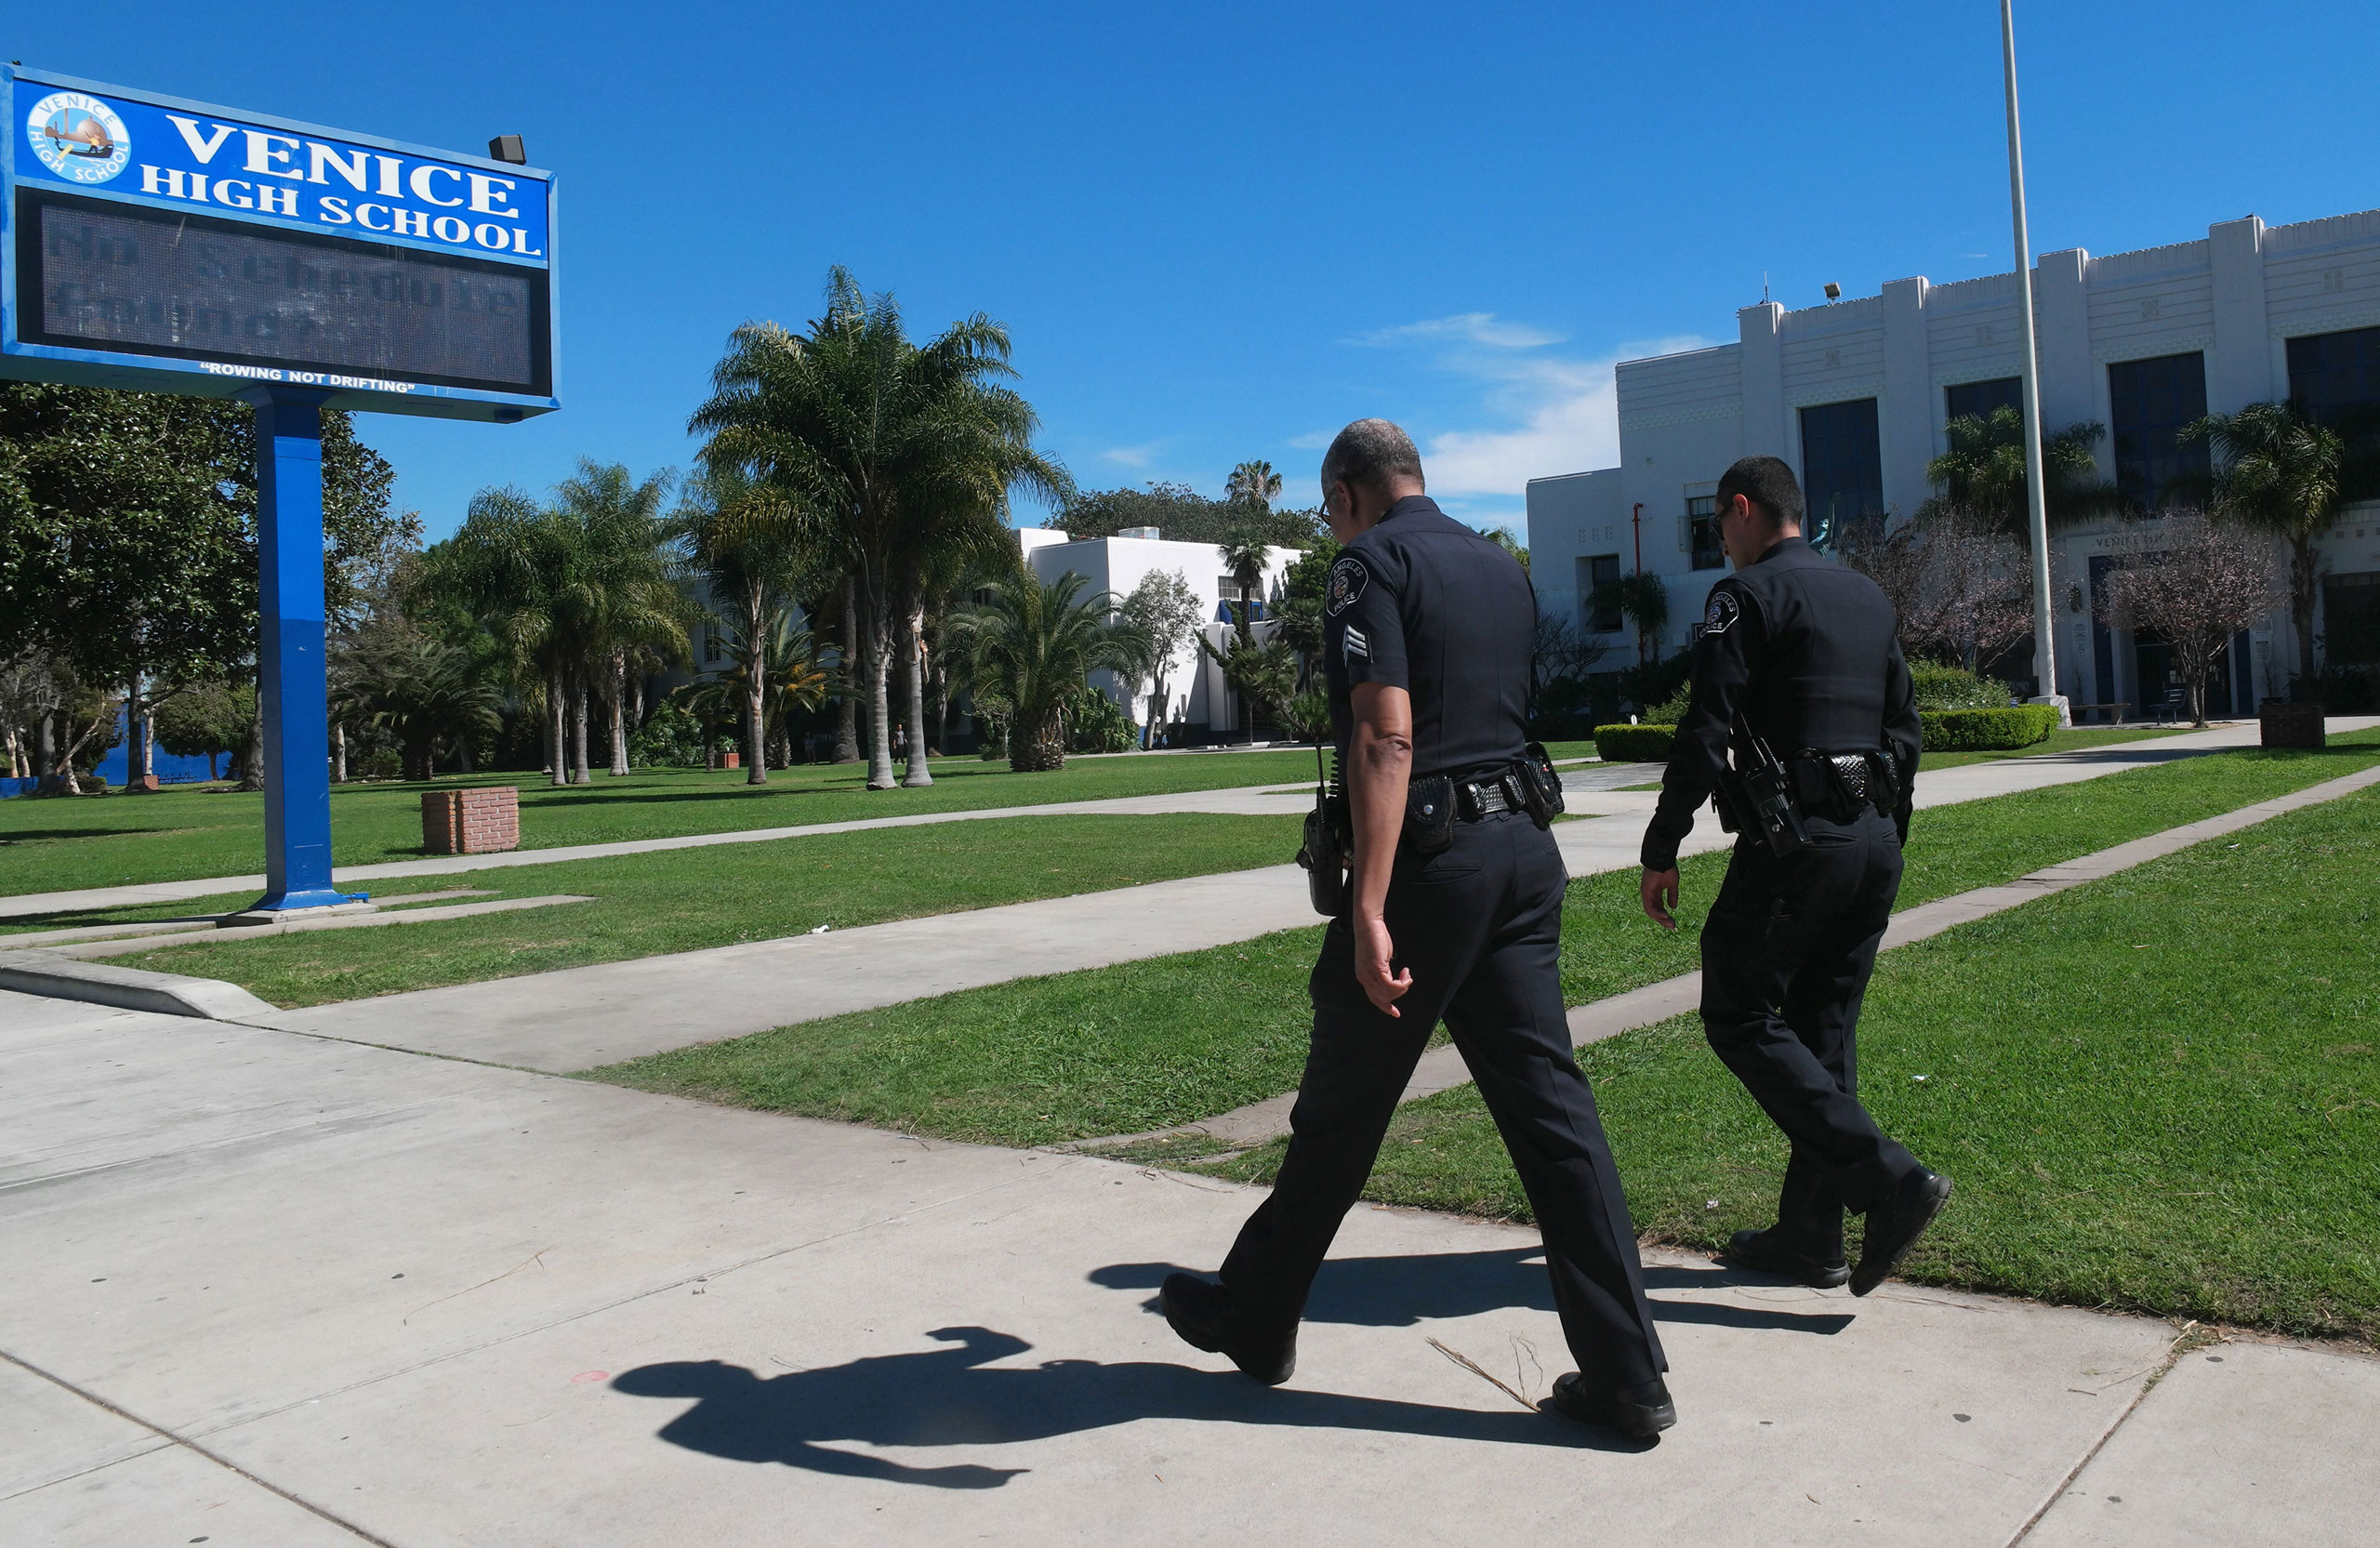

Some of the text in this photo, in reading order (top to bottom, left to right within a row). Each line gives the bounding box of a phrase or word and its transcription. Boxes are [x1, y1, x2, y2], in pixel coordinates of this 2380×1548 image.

[38, 95, 117, 125] VENICE
[30, 131, 128, 181] HIGH SCHOOL
[165, 114, 519, 218] VENICE
[139, 164, 541, 256] HIGH SCHOOL
[200, 362, 416, 393] “ROWING NOT DRIFTING”
[1333, 562, 1364, 577] ANGELES
[1333, 591, 1355, 613] POLICE
